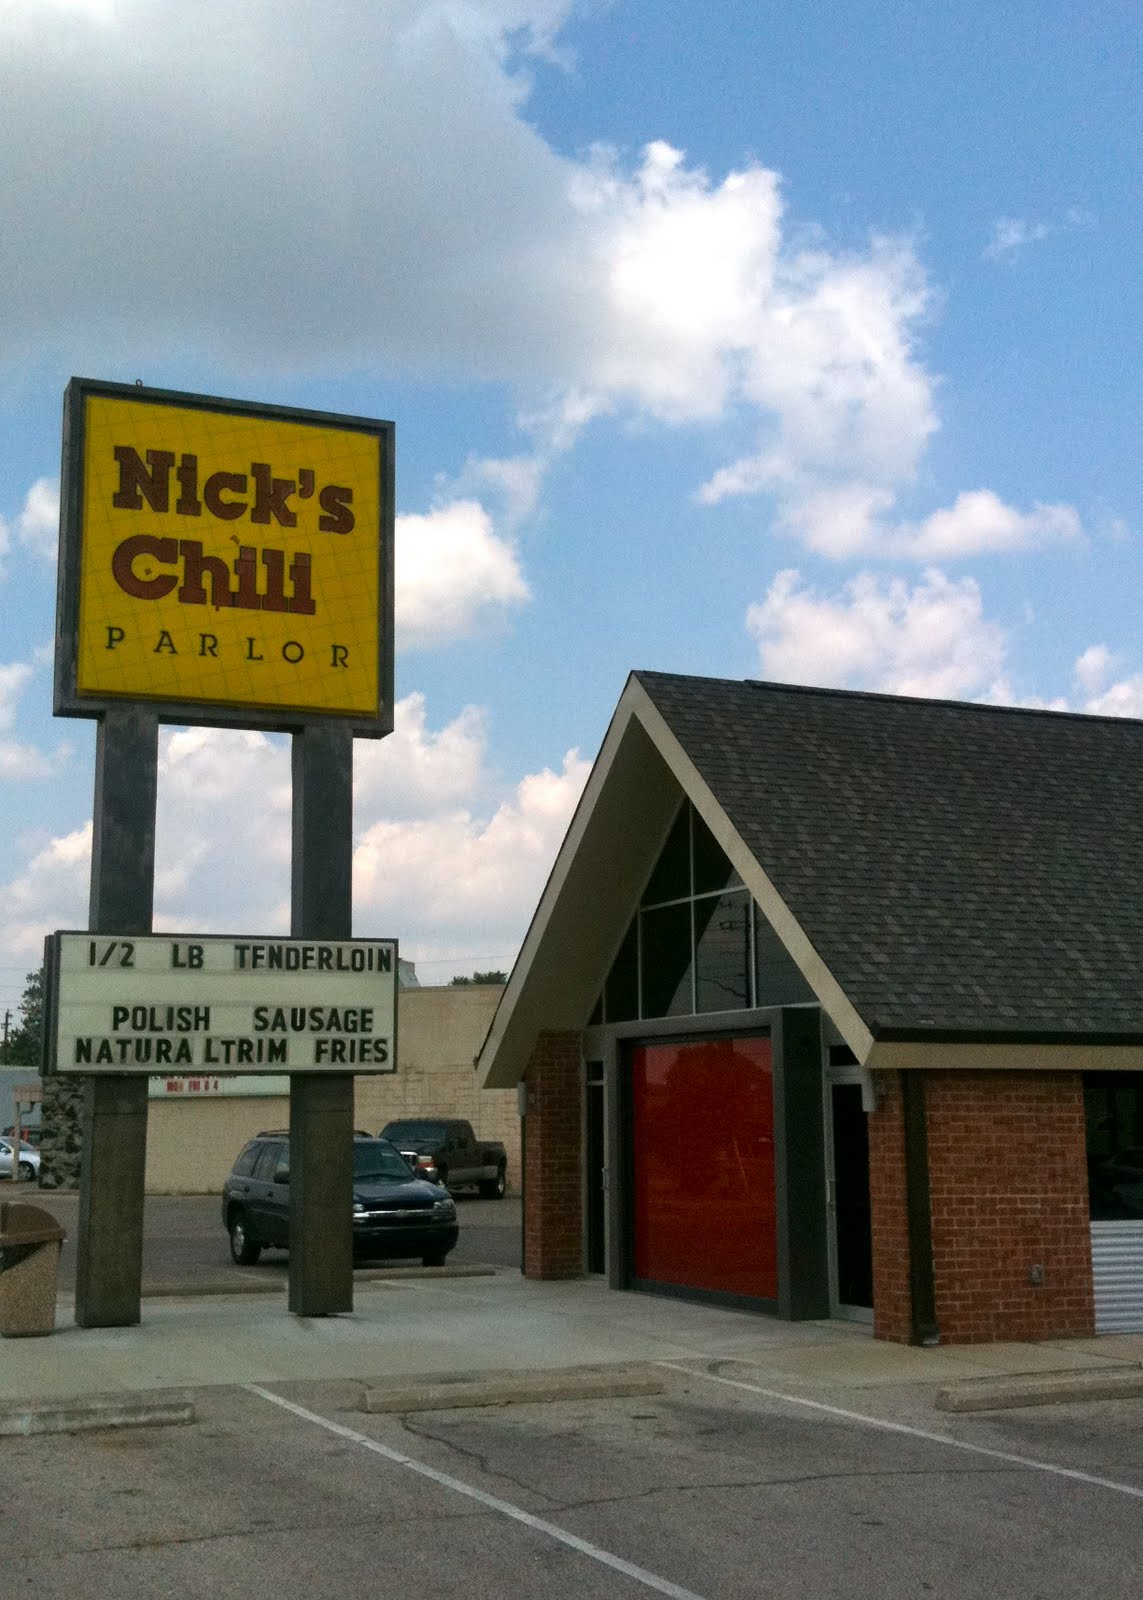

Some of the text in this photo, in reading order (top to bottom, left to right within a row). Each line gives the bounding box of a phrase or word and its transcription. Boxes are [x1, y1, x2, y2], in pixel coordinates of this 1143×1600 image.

[113, 445, 355, 535] Nick's
[112, 533, 316, 615] Chili
[106, 626, 349, 668] PARLOR
[90, 941, 392, 972] 1/2 LB TENDERLOIN
[113, 1006, 374, 1032] POLISH SAUSAGE
[315, 1038, 388, 1063] FRIES
